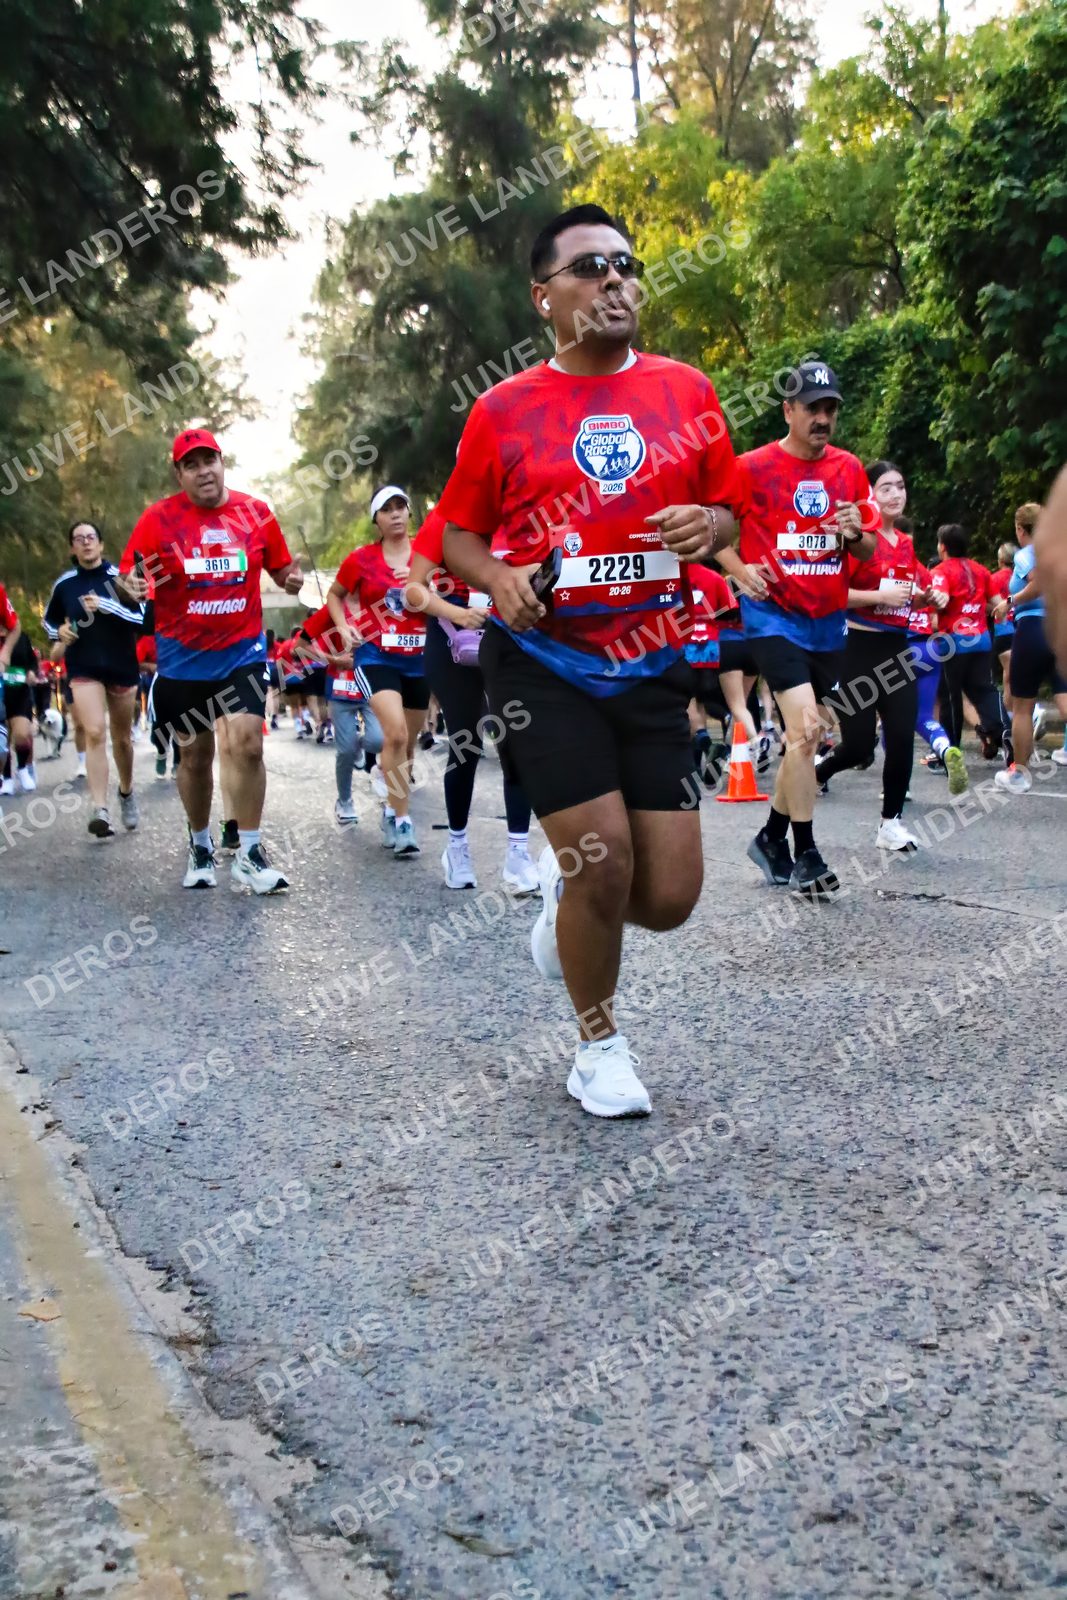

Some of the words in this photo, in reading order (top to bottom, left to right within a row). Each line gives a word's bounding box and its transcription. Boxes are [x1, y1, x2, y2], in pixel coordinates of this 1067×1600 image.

[588, 421, 626, 431] BIMBO
[590, 432, 627, 446] Global
[584, 445, 614, 457] Race
[602, 482, 624, 493] 2026
[798, 535, 827, 549] 3078
[205, 558, 230, 572] 3619
[588, 554, 645, 583] 2229
[186, 597, 247, 615] SANTIAGO
[397, 635, 420, 646] 2566
